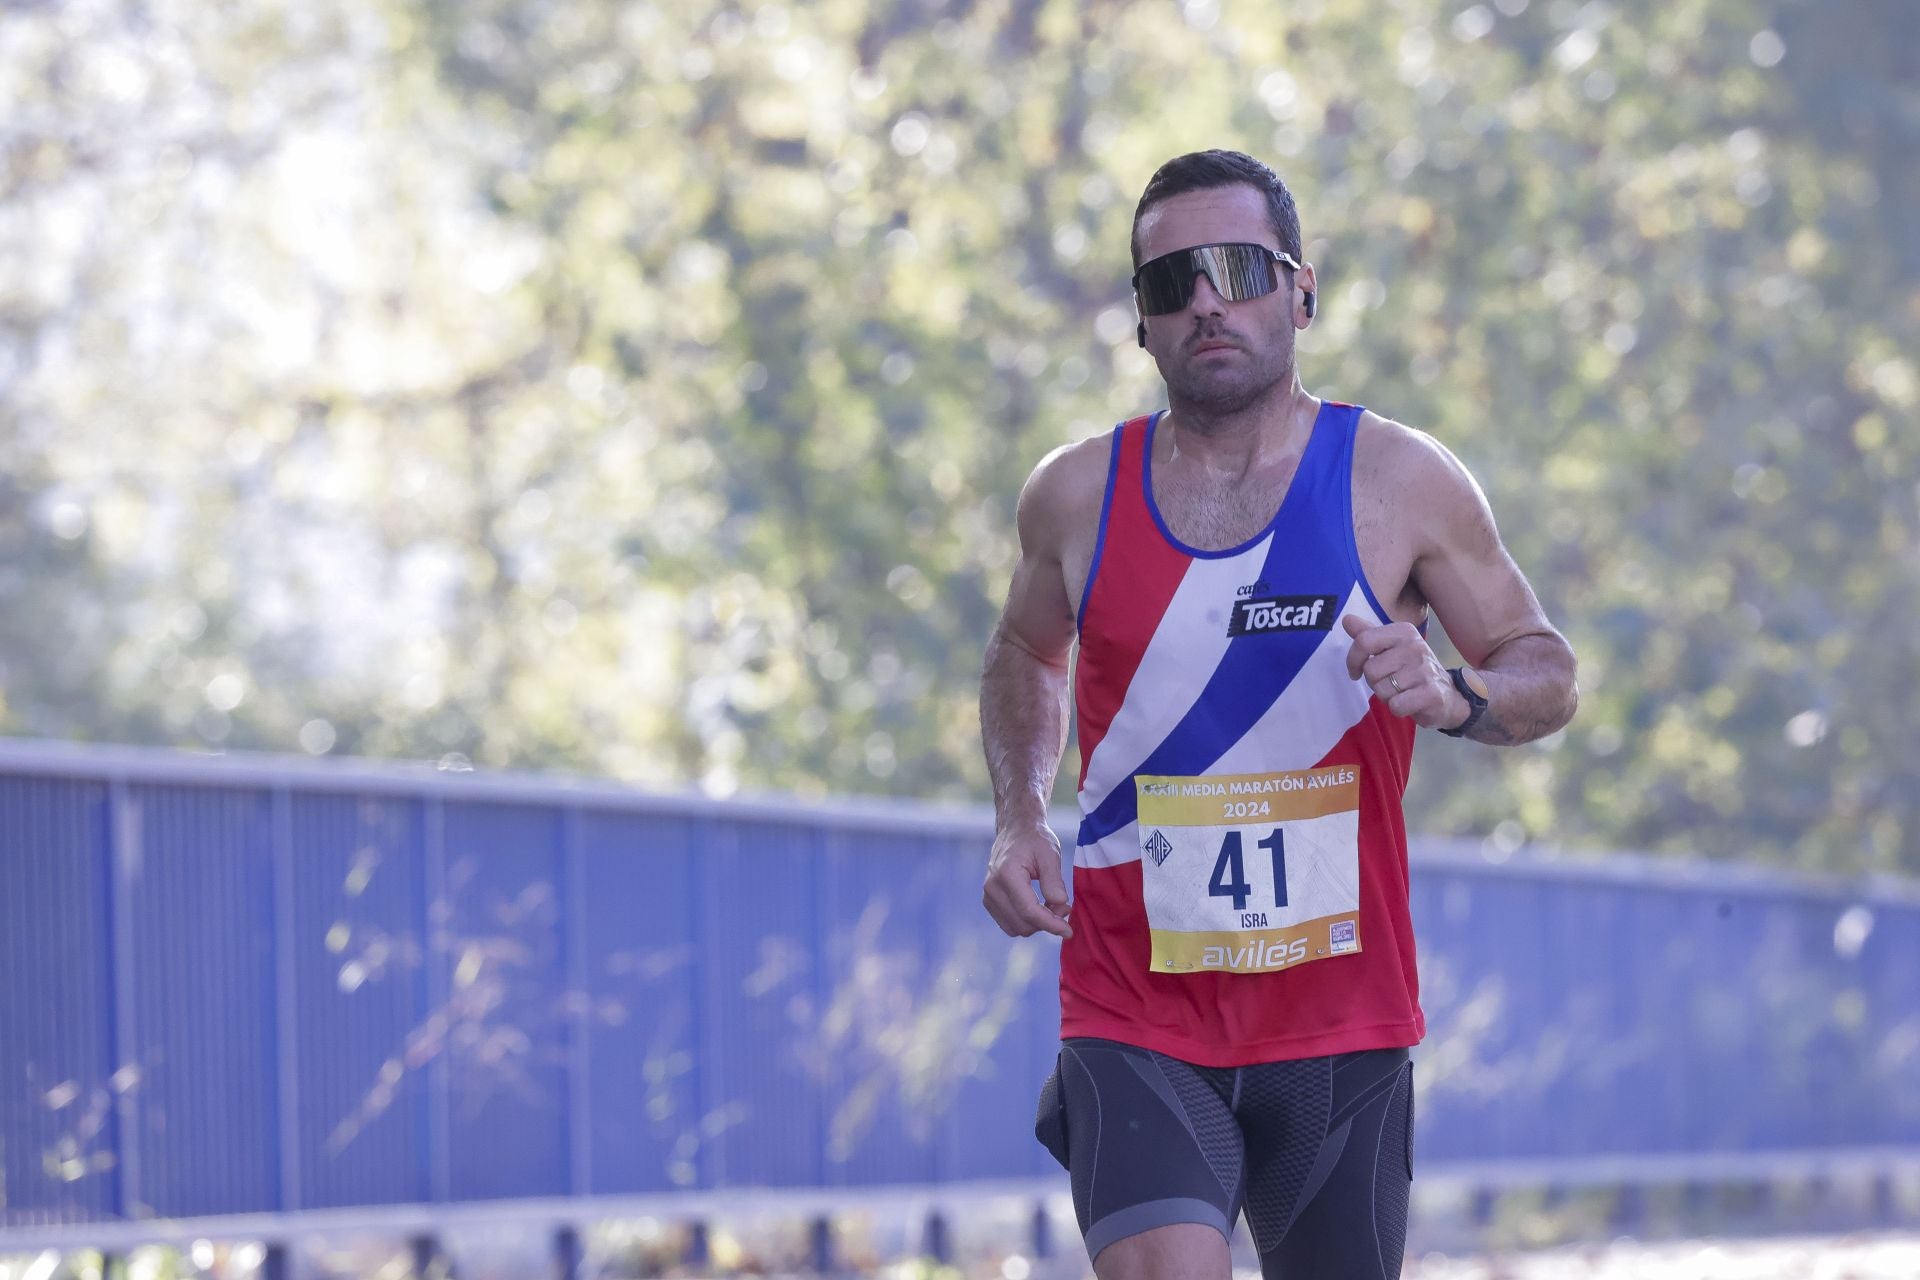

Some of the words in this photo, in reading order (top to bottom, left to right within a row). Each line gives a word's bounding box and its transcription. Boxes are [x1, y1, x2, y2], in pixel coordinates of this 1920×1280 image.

[1241, 599, 1325, 631] Toscaf
[1182, 783, 1227, 797] MEDIA
[1229, 775, 1304, 795] MARATÓN
[1307, 768, 1355, 790] AVILÉS
[1223, 801, 1271, 818] 2024
[1208, 828, 1288, 910] 41
[1241, 912, 1268, 928] ISRA
[1202, 937, 1308, 969] avilés
